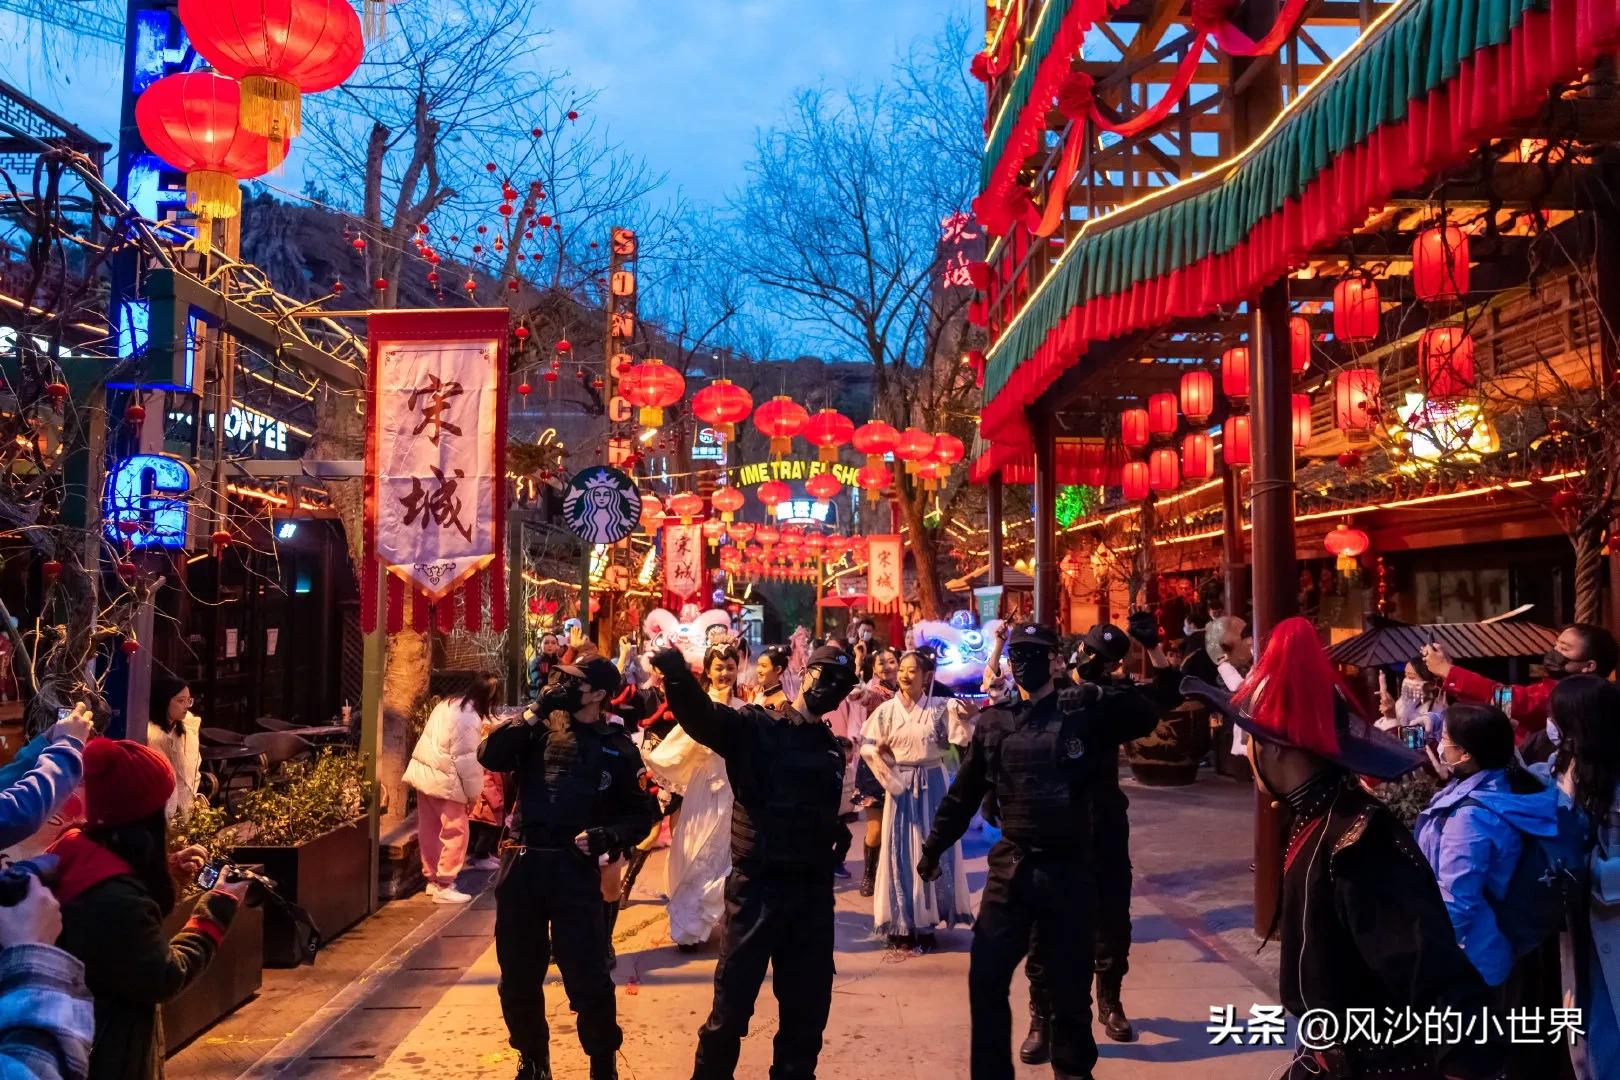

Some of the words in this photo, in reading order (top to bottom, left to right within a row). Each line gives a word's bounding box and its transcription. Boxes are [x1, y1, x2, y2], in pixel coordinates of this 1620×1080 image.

[400, 373, 472, 544] 宋城
[674, 535, 696, 584] 宋城
[876, 549, 895, 591] 宋城
